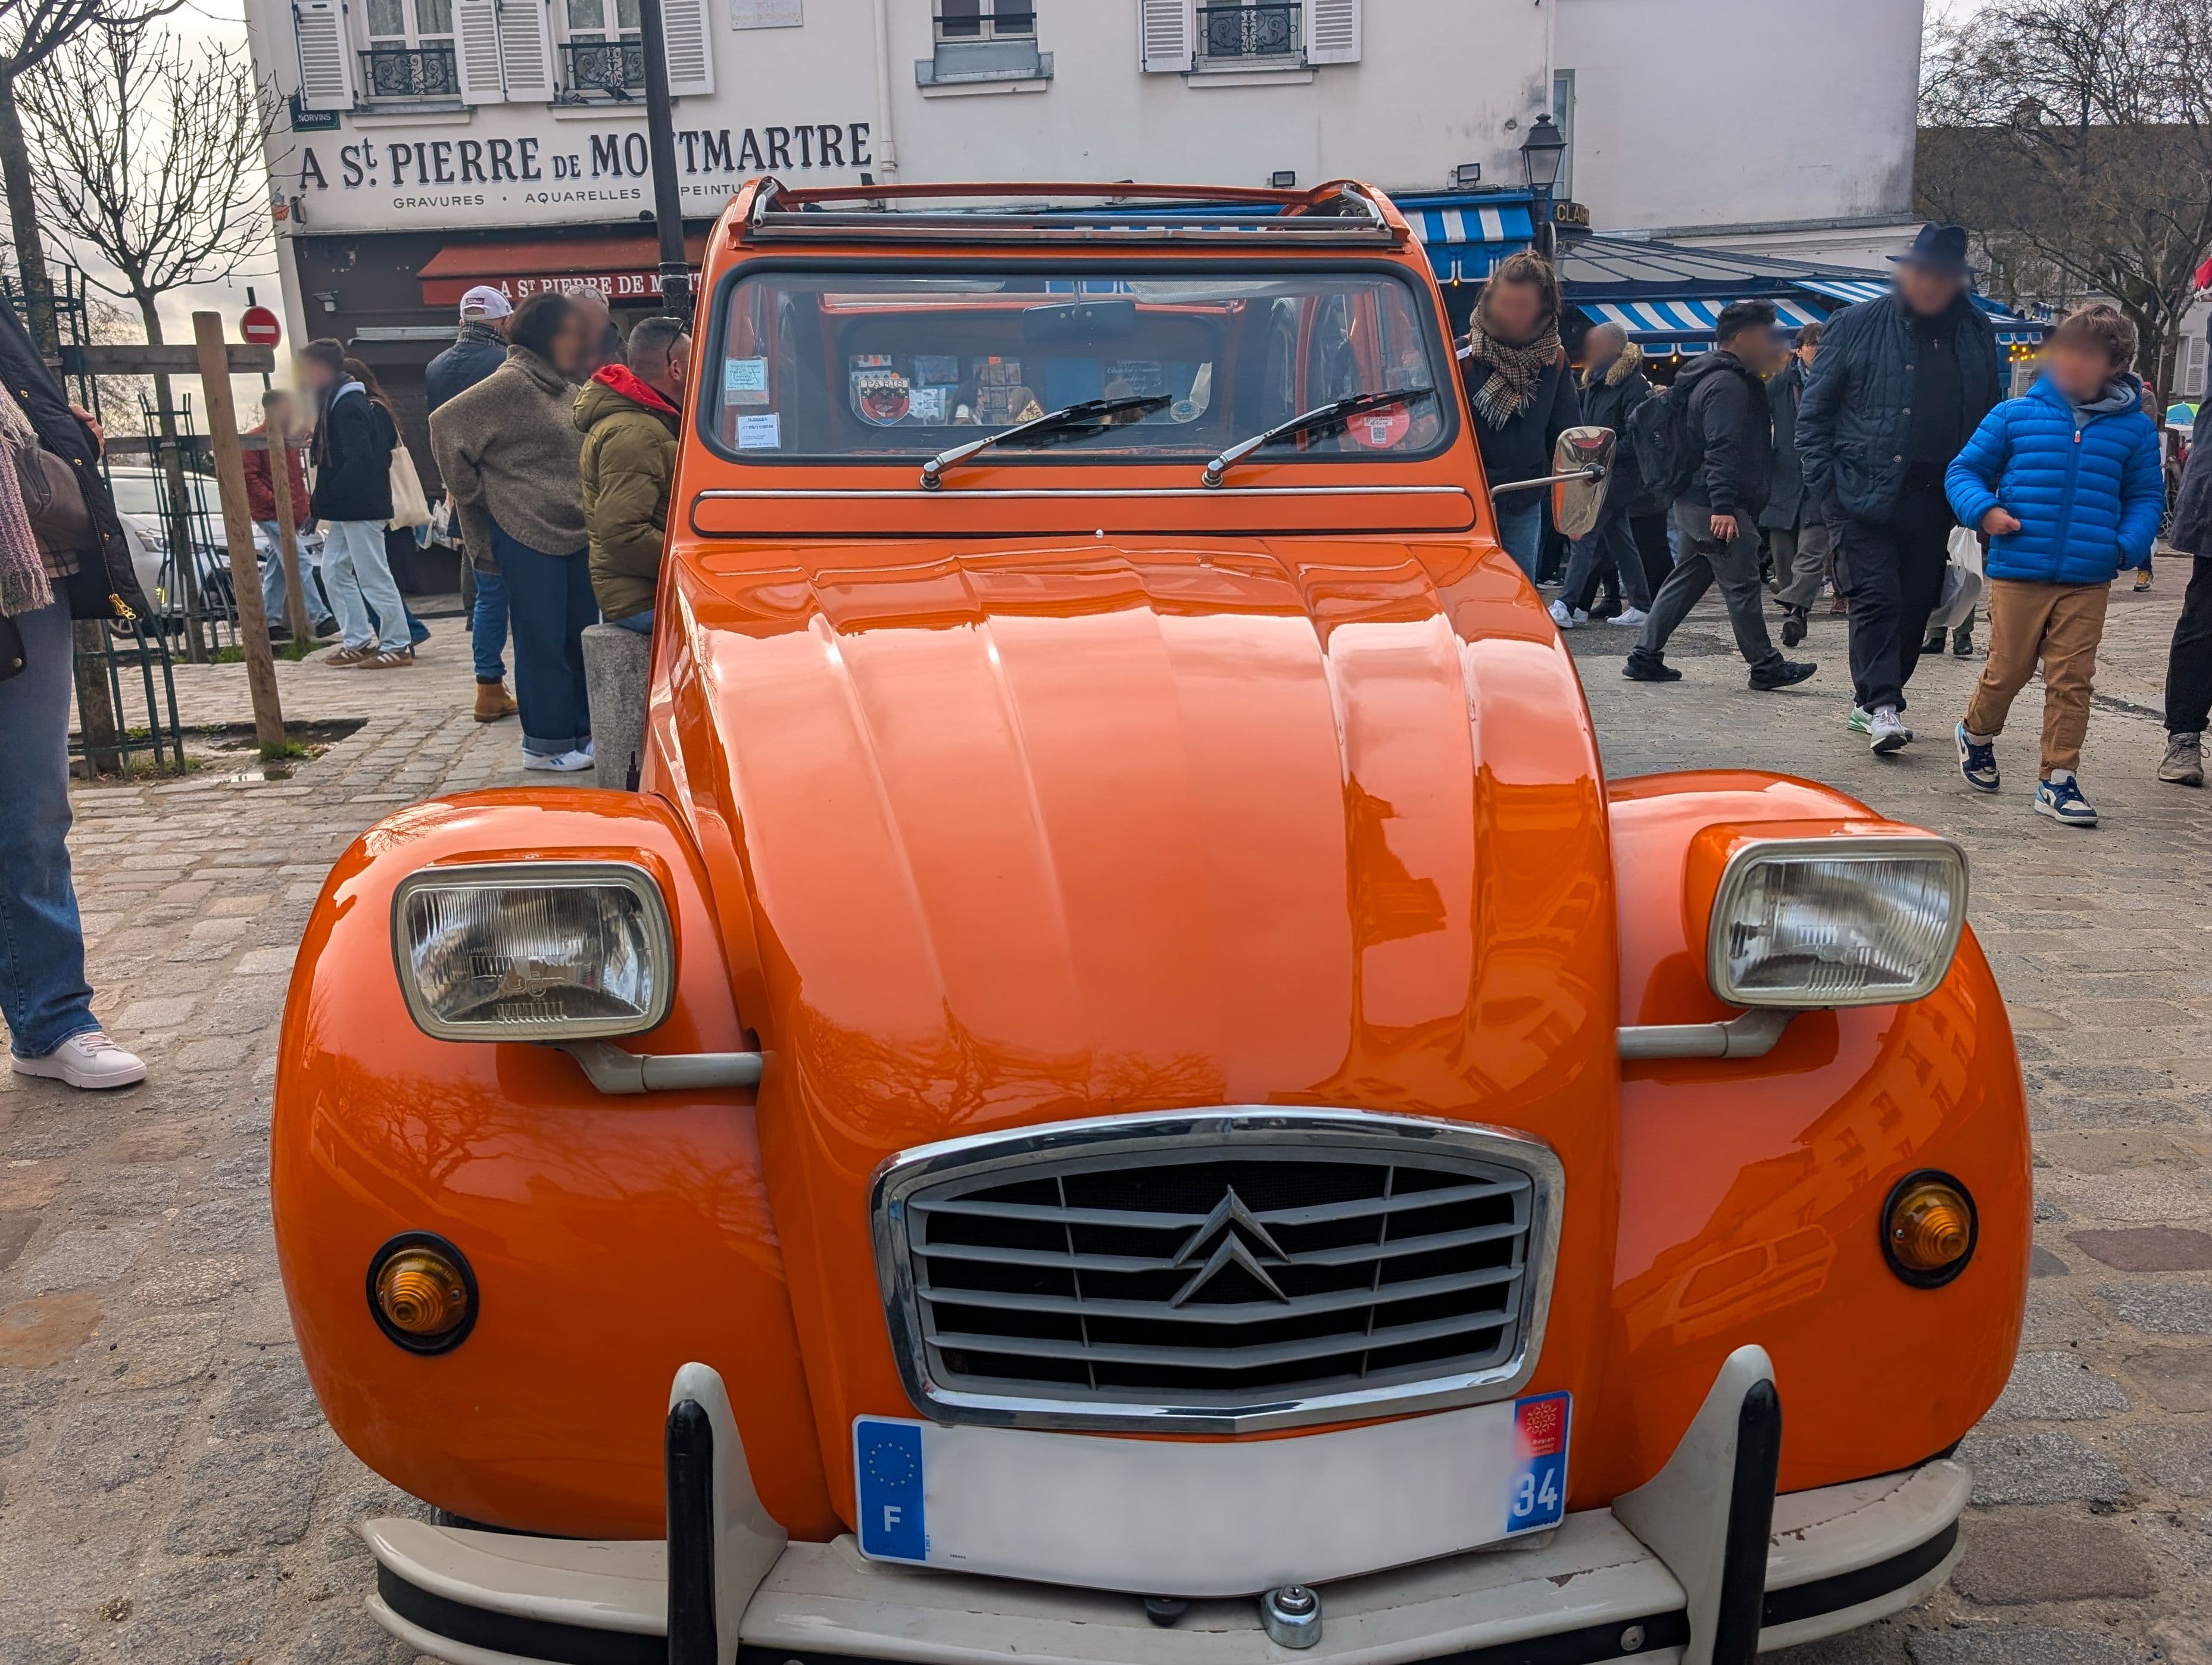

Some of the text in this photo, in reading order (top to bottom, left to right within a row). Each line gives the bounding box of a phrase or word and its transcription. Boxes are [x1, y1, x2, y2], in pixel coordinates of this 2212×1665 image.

[298, 114, 331, 122] NORVINS
[299, 147, 329, 190] A
[386, 138, 542, 186] PIERRE
[553, 155, 581, 179] DE
[589, 123, 872, 178] MOTMARTRE
[393, 184, 741, 209] GRAVURES AQUARELLES PEINTU
[501, 280, 513, 298] A
[617, 276, 645, 294] DE
[1514, 1468, 1558, 1517] 34
[884, 1505, 901, 1532] F
